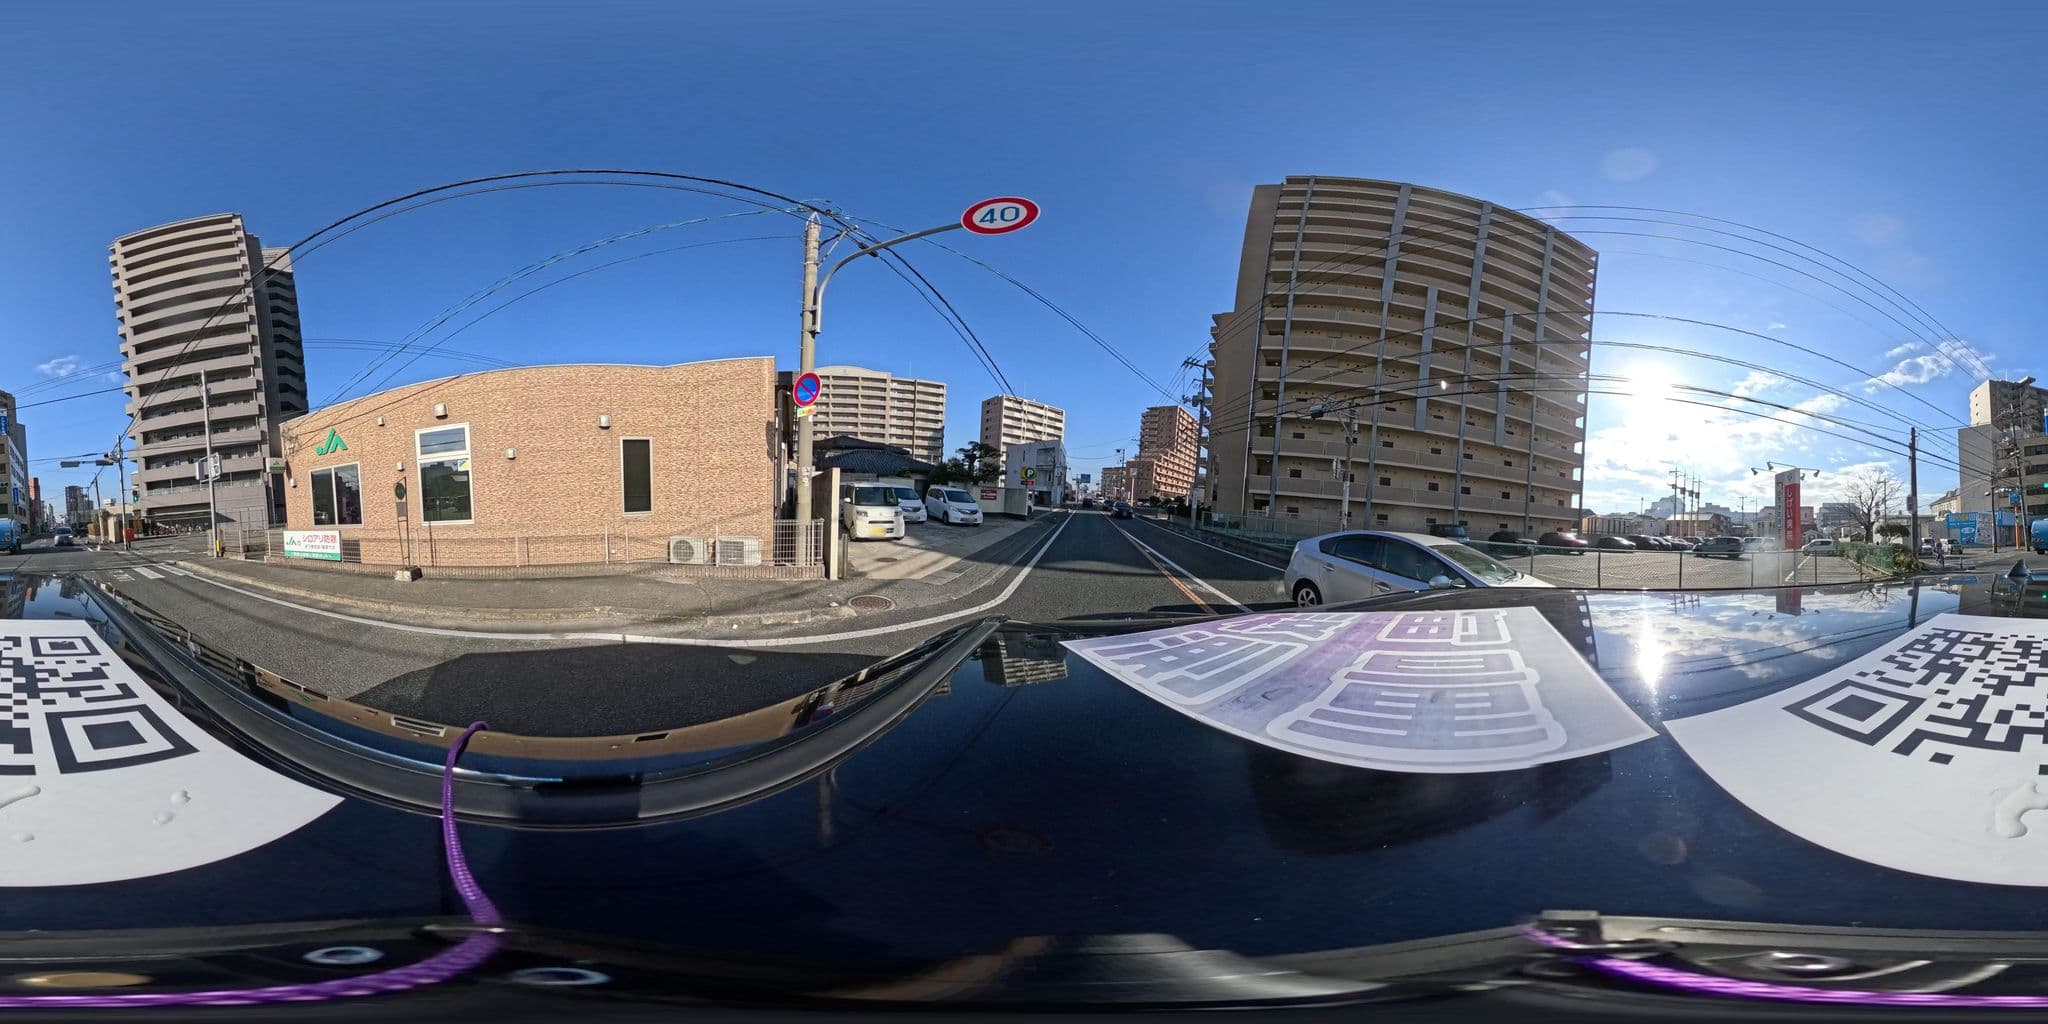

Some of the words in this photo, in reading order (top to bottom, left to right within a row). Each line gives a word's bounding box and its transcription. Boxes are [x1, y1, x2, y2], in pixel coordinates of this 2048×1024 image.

[979, 206, 1019, 223] 40
[315, 427, 348, 456] JA
[1082, 630, 1567, 754] 測量
